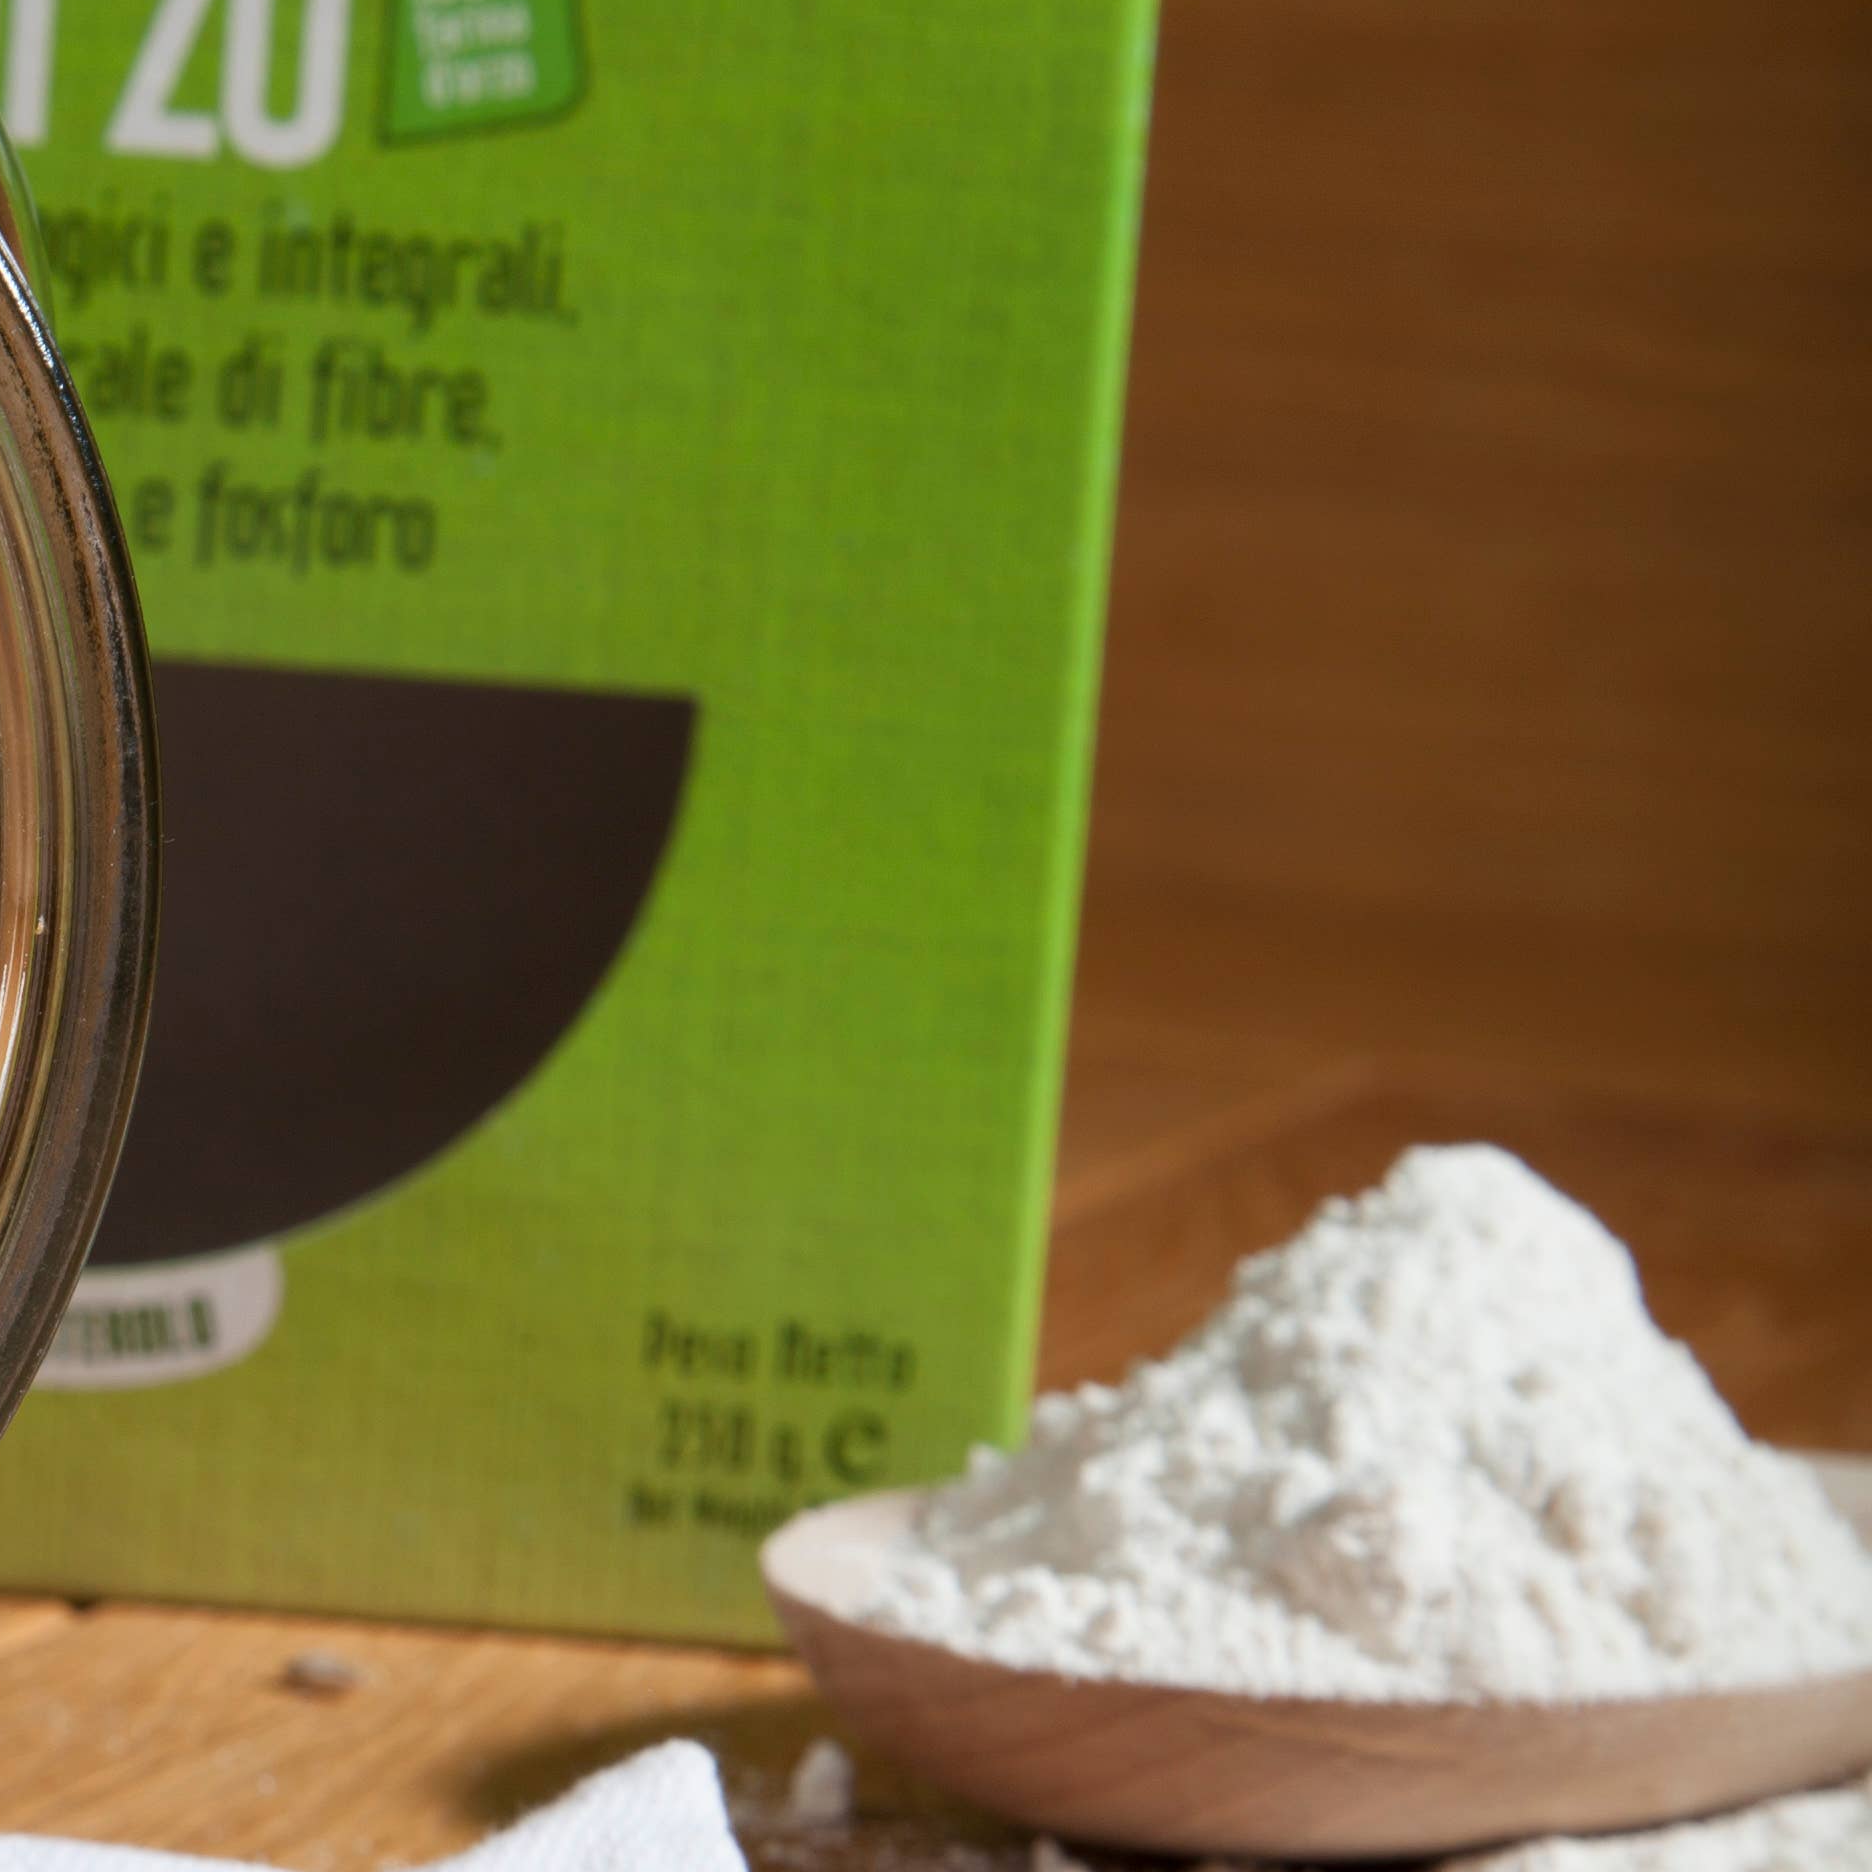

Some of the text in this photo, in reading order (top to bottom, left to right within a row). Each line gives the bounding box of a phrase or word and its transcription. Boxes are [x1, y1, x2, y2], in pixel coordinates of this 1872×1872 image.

[191, 216, 237, 299] e
[217, 331, 285, 429] di
[131, 455, 441, 578] e fosforo
[640, 1306, 920, 1394] Peso Netto
